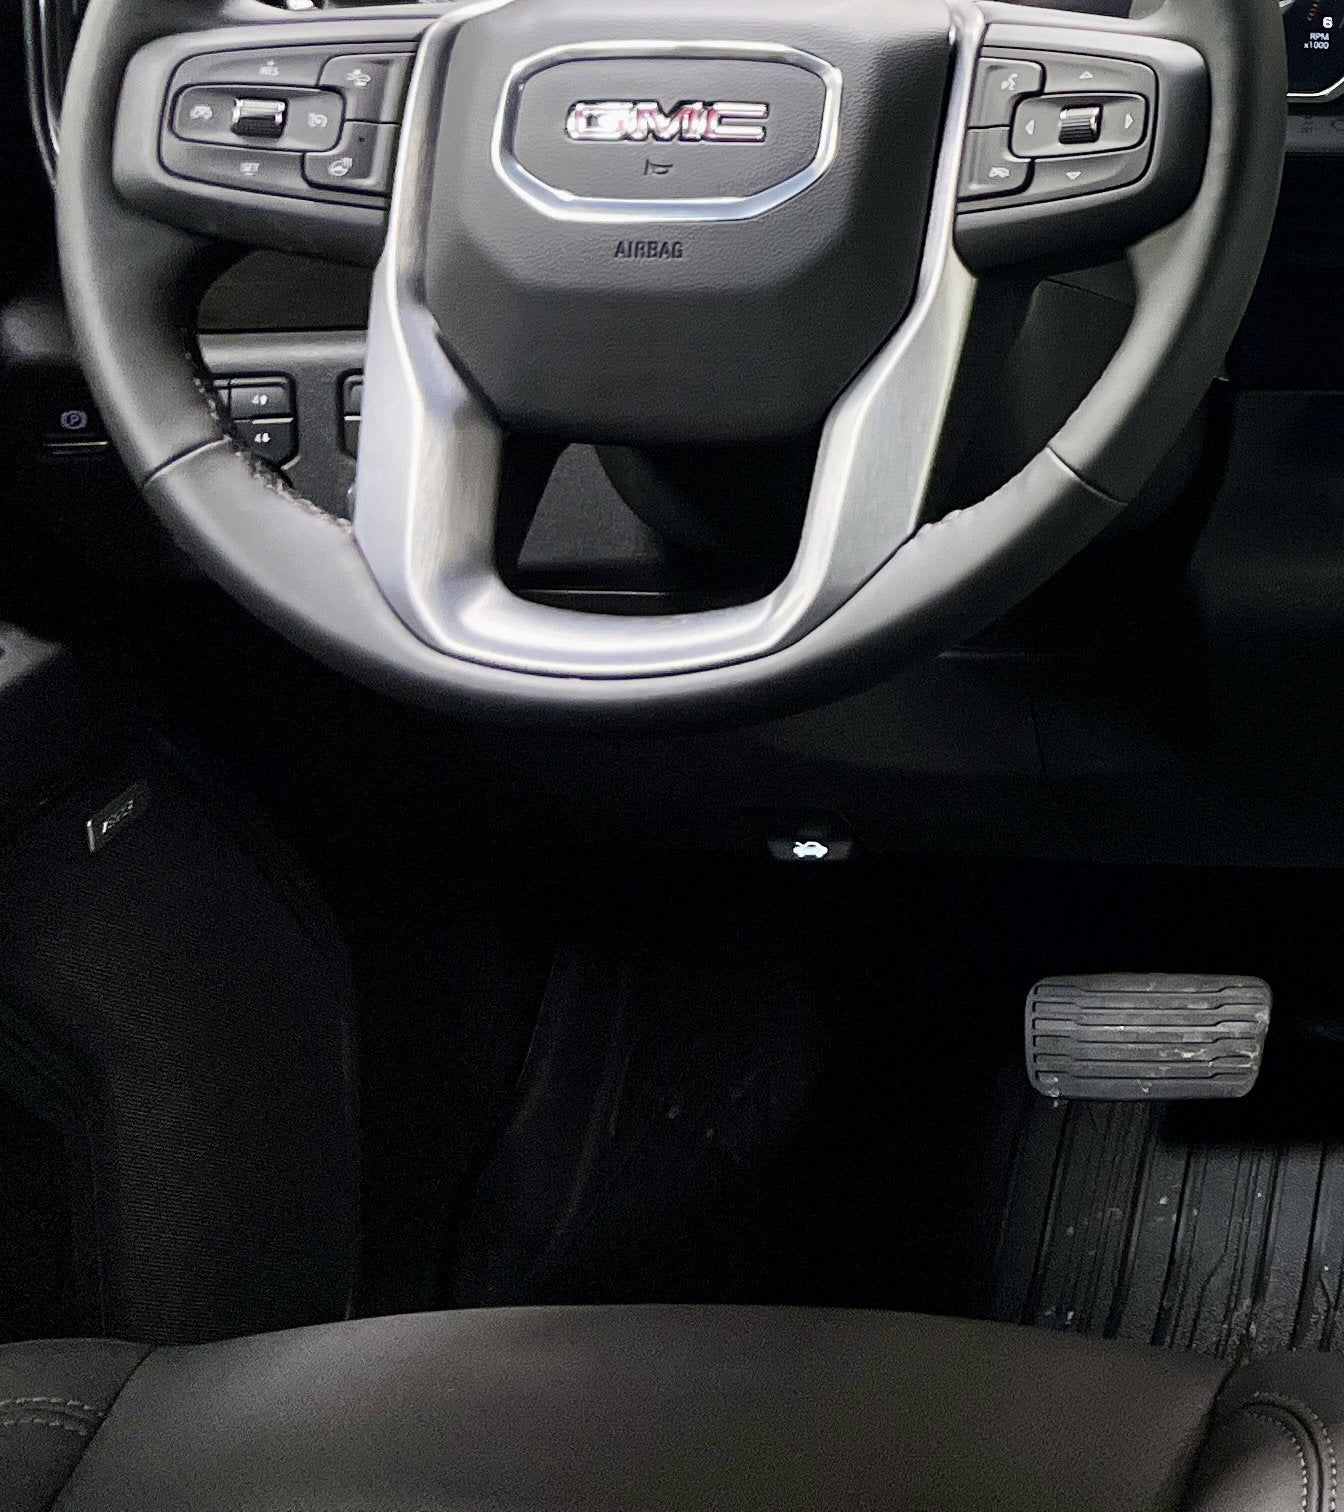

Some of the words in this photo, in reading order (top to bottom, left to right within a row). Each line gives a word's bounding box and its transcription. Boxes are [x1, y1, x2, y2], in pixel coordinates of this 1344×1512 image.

[1323, 17, 1333, 28] 6
[566, 100, 768, 144] GMC
[614, 240, 683, 259] AIRBAG
